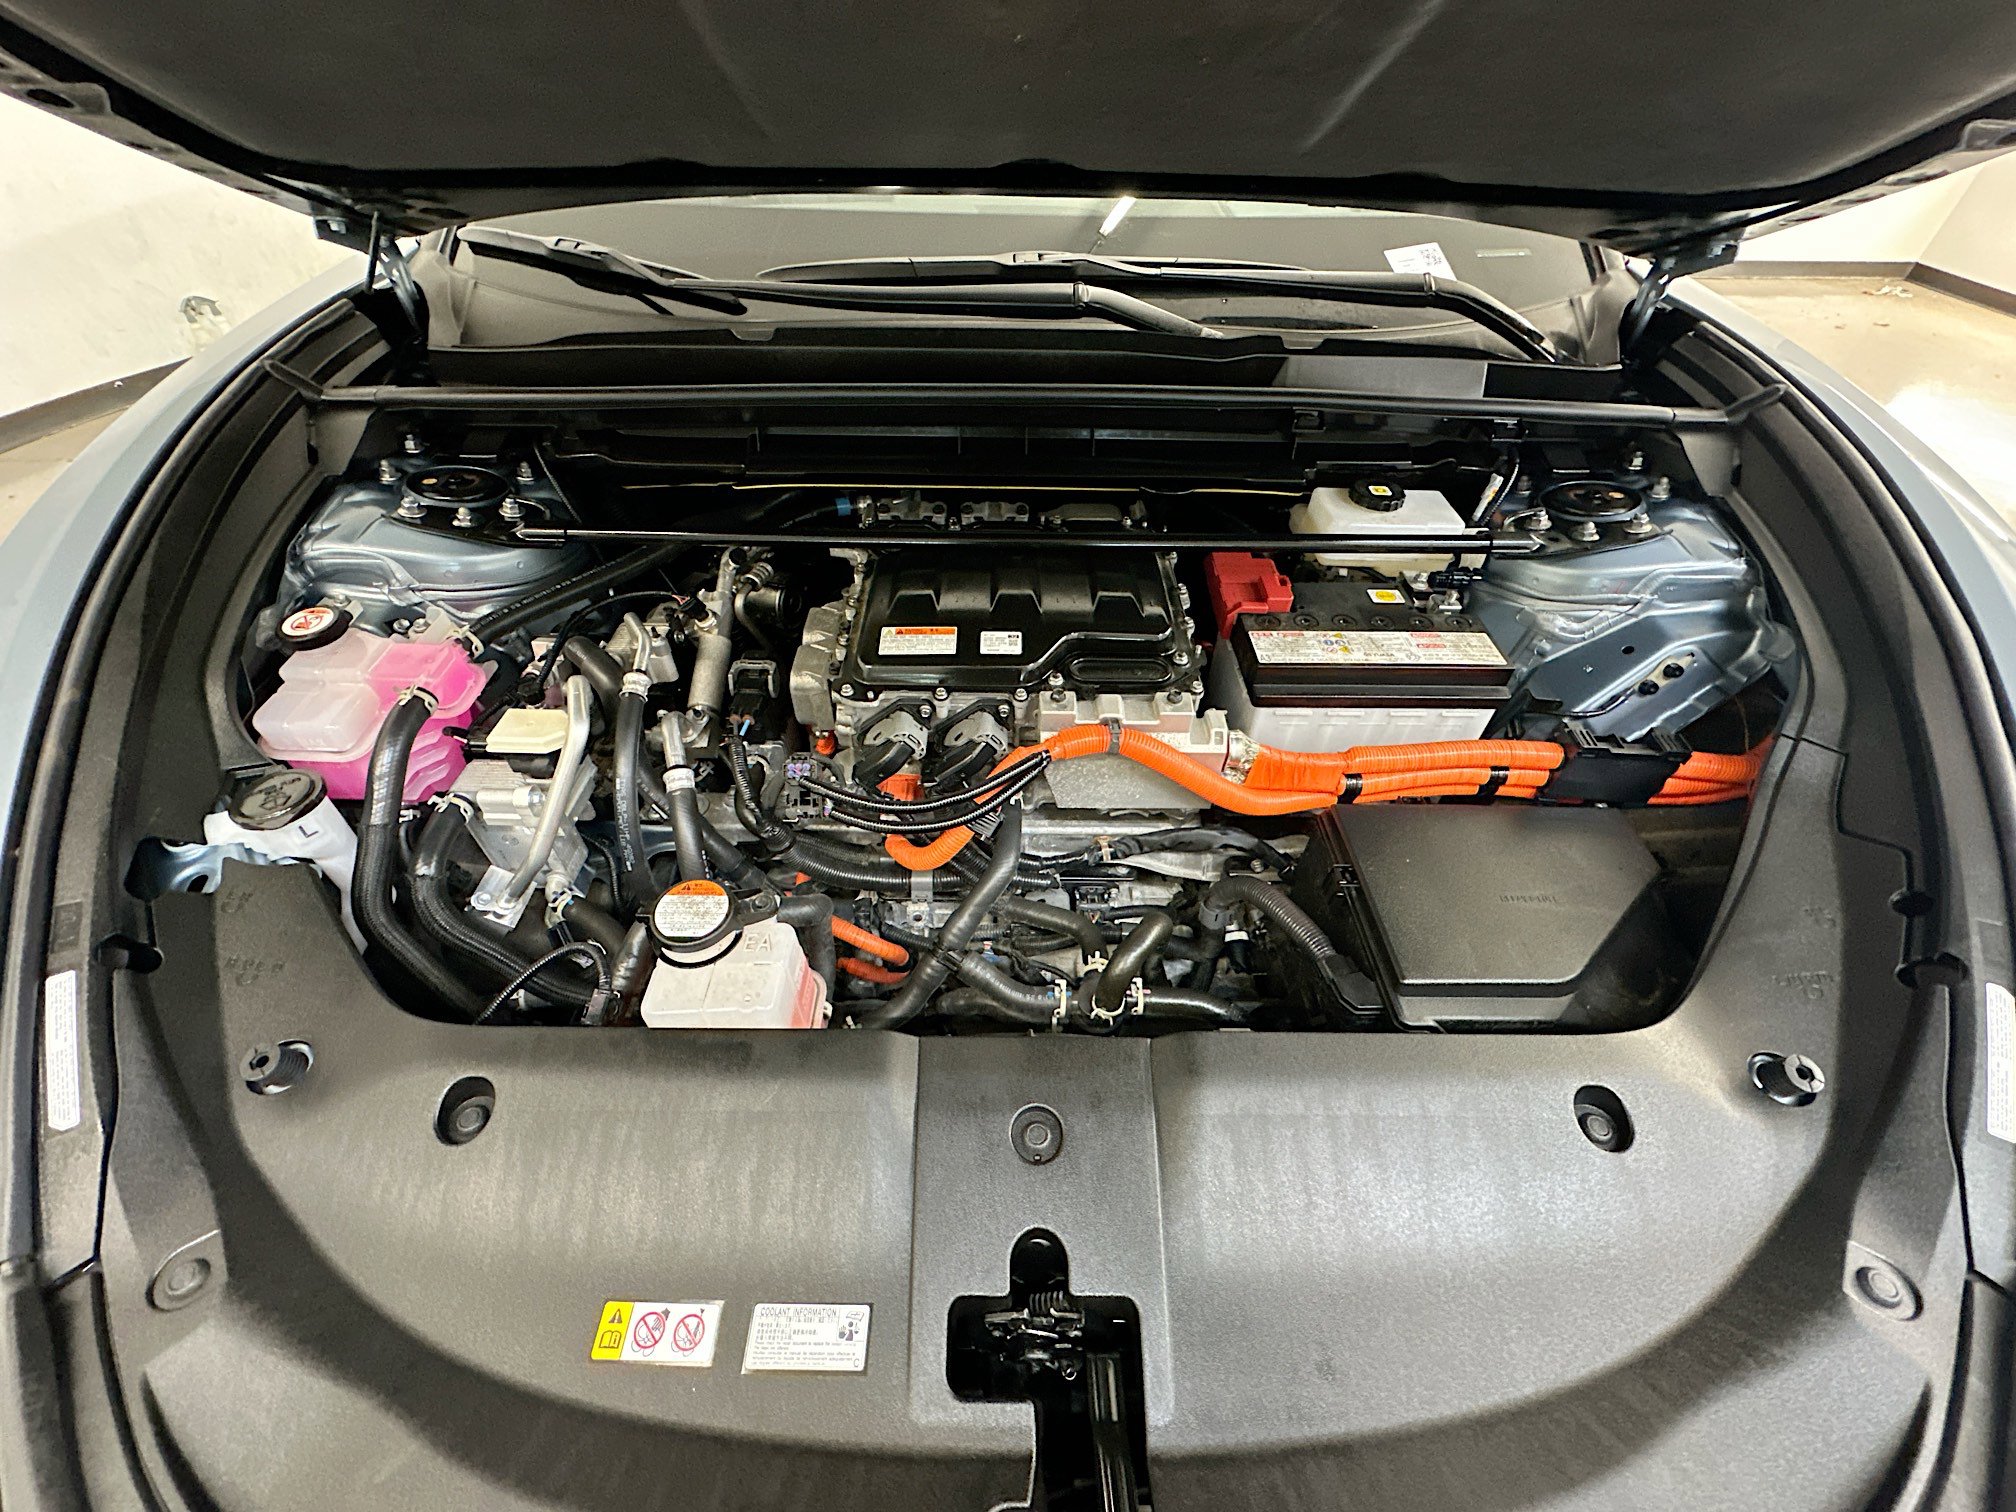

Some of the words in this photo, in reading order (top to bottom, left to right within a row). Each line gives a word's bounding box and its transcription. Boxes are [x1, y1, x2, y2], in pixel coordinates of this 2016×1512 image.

[298, 825, 319, 838] L
[744, 933, 772, 952] EA
[760, 1307, 791, 1317] COOLANT
[793, 1308, 837, 1318] INFORMATION
[853, 1359, 860, 1368] C
